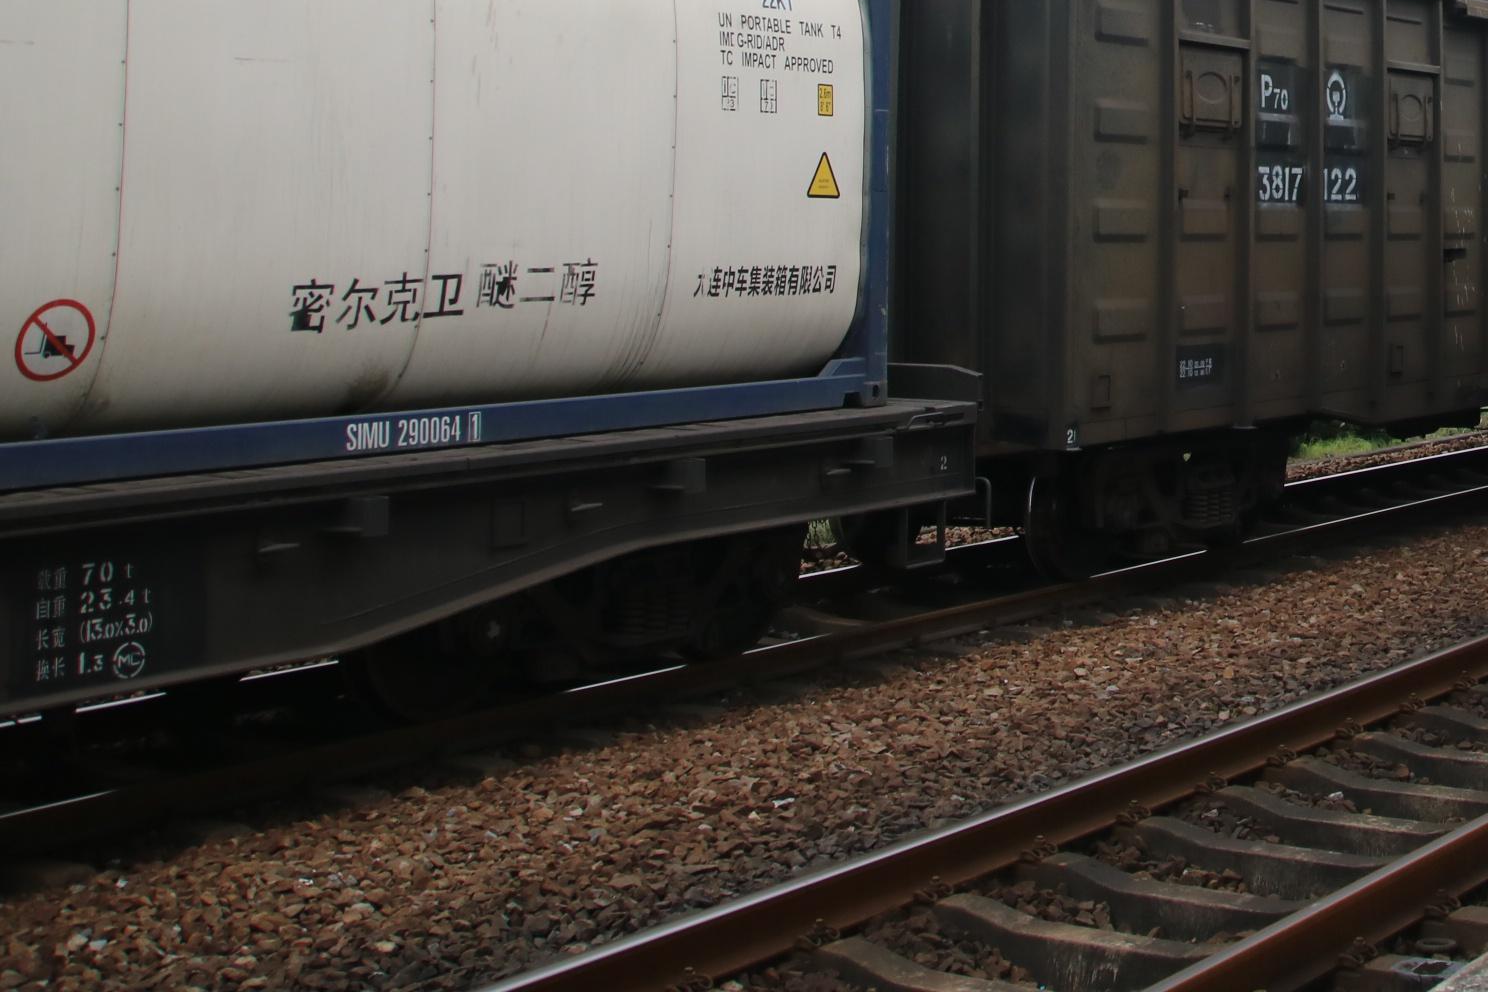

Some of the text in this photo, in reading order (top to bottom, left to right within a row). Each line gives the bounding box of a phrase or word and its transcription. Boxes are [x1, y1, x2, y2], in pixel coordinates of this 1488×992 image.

[718, 12, 842, 40] UN PORTABLE TANK T4
[720, 50, 834, 74] TC IMPACT APPROVED
[1261, 74, 1288, 110] P70
[1258, 165, 1357, 201] 3817 122
[290, 271, 464, 333] 密尔克卫
[346, 412, 480, 451] SIMU 290064 1
[940, 455, 948, 471] 2
